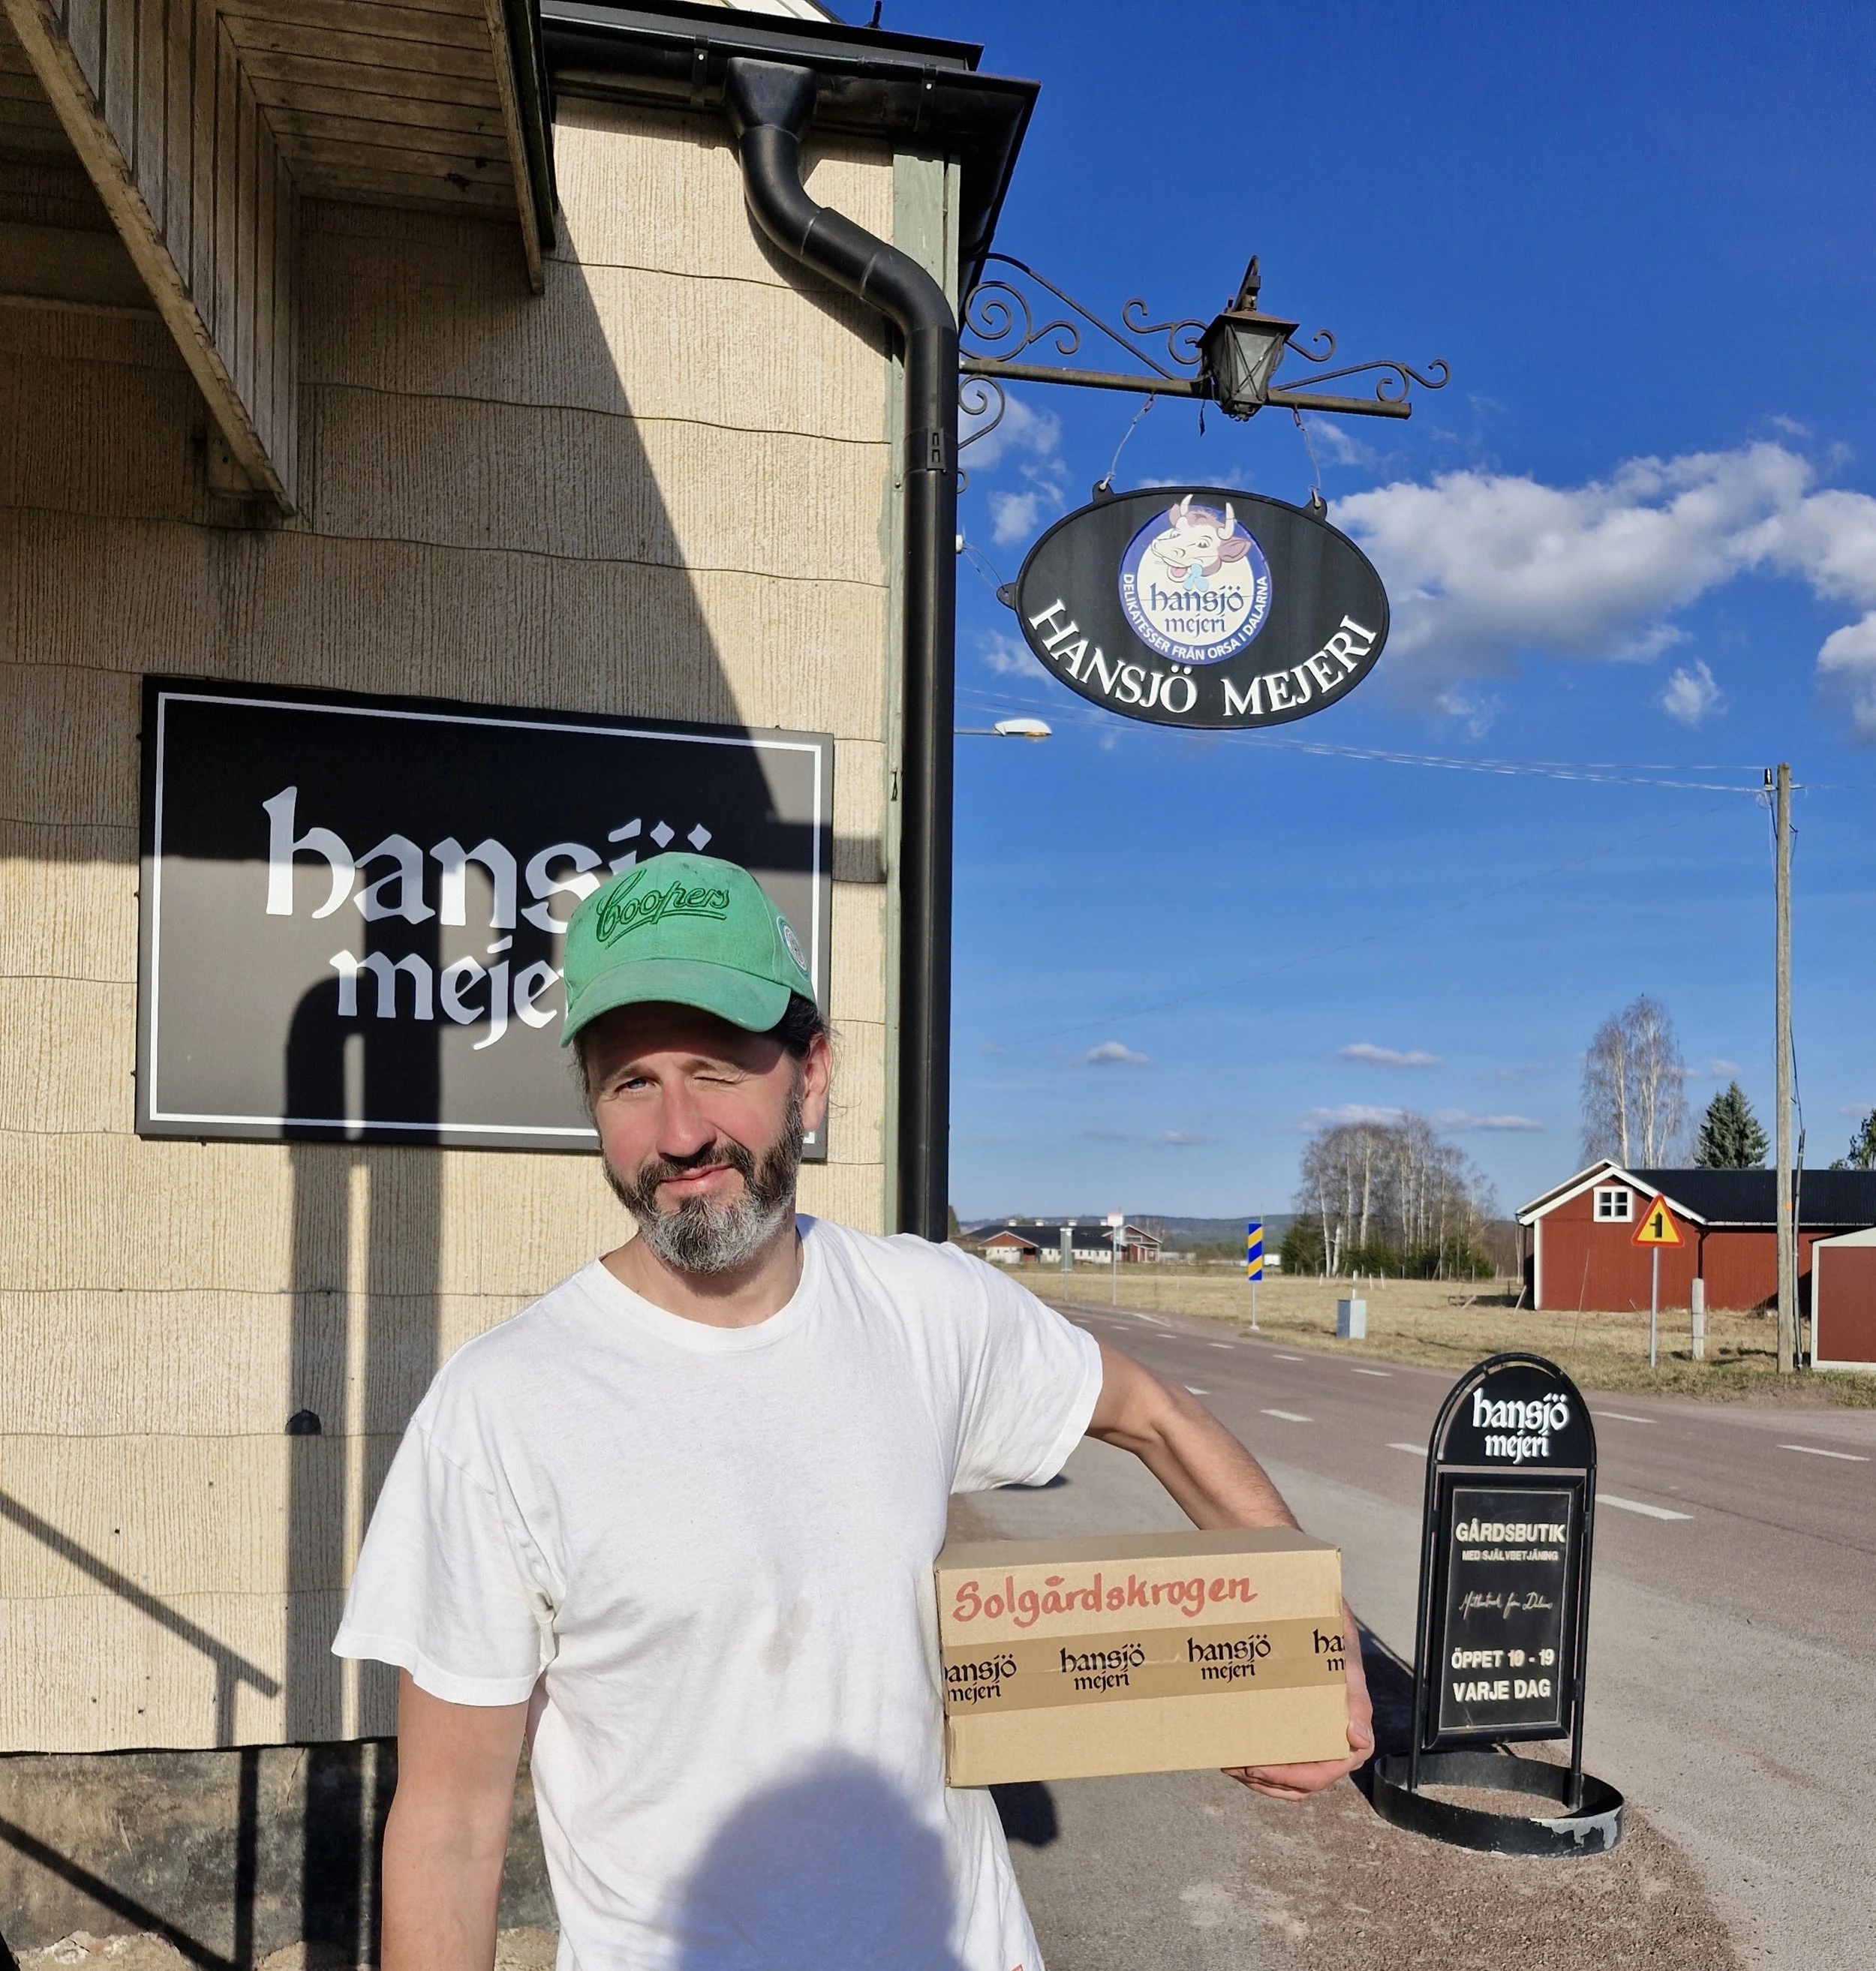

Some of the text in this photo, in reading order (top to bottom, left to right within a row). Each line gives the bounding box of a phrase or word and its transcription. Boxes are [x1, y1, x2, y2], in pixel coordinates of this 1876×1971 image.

[1150, 582, 1244, 615] hansjö
[1123, 574, 1267, 660] DELIKATESSER FRÅN ORSA I DALARNA
[1165, 614, 1226, 638] mejeri
[1028, 599, 1378, 717] HANSJÖ MEJERI
[263, 786, 711, 934] hans
[596, 869, 729, 945] Coopers
[329, 936, 568, 1050] meje
[1472, 1387, 1570, 1434] hansjö
[1484, 1429, 1550, 1465] mejeri
[1455, 1518, 1565, 1543] GÅRDSBUTIK
[1462, 1548, 1559, 1561] MED SJÄLVBETJÄNING
[952, 1573, 1258, 1628] Solgårdskrogen
[1060, 1643, 1145, 1672] hansjö
[1186, 1634, 1271, 1662] hansjö
[1451, 1647, 1504, 1669] ÖPPET
[1508, 1649, 1525, 1667] 10
[1539, 1648, 1555, 1666] 19
[1074, 1669, 1129, 1693] mejeri
[1201, 1660, 1256, 1683] mejeri
[948, 1680, 1001, 1705] mejeri
[1453, 1678, 1551, 1702] VARJE DAG
